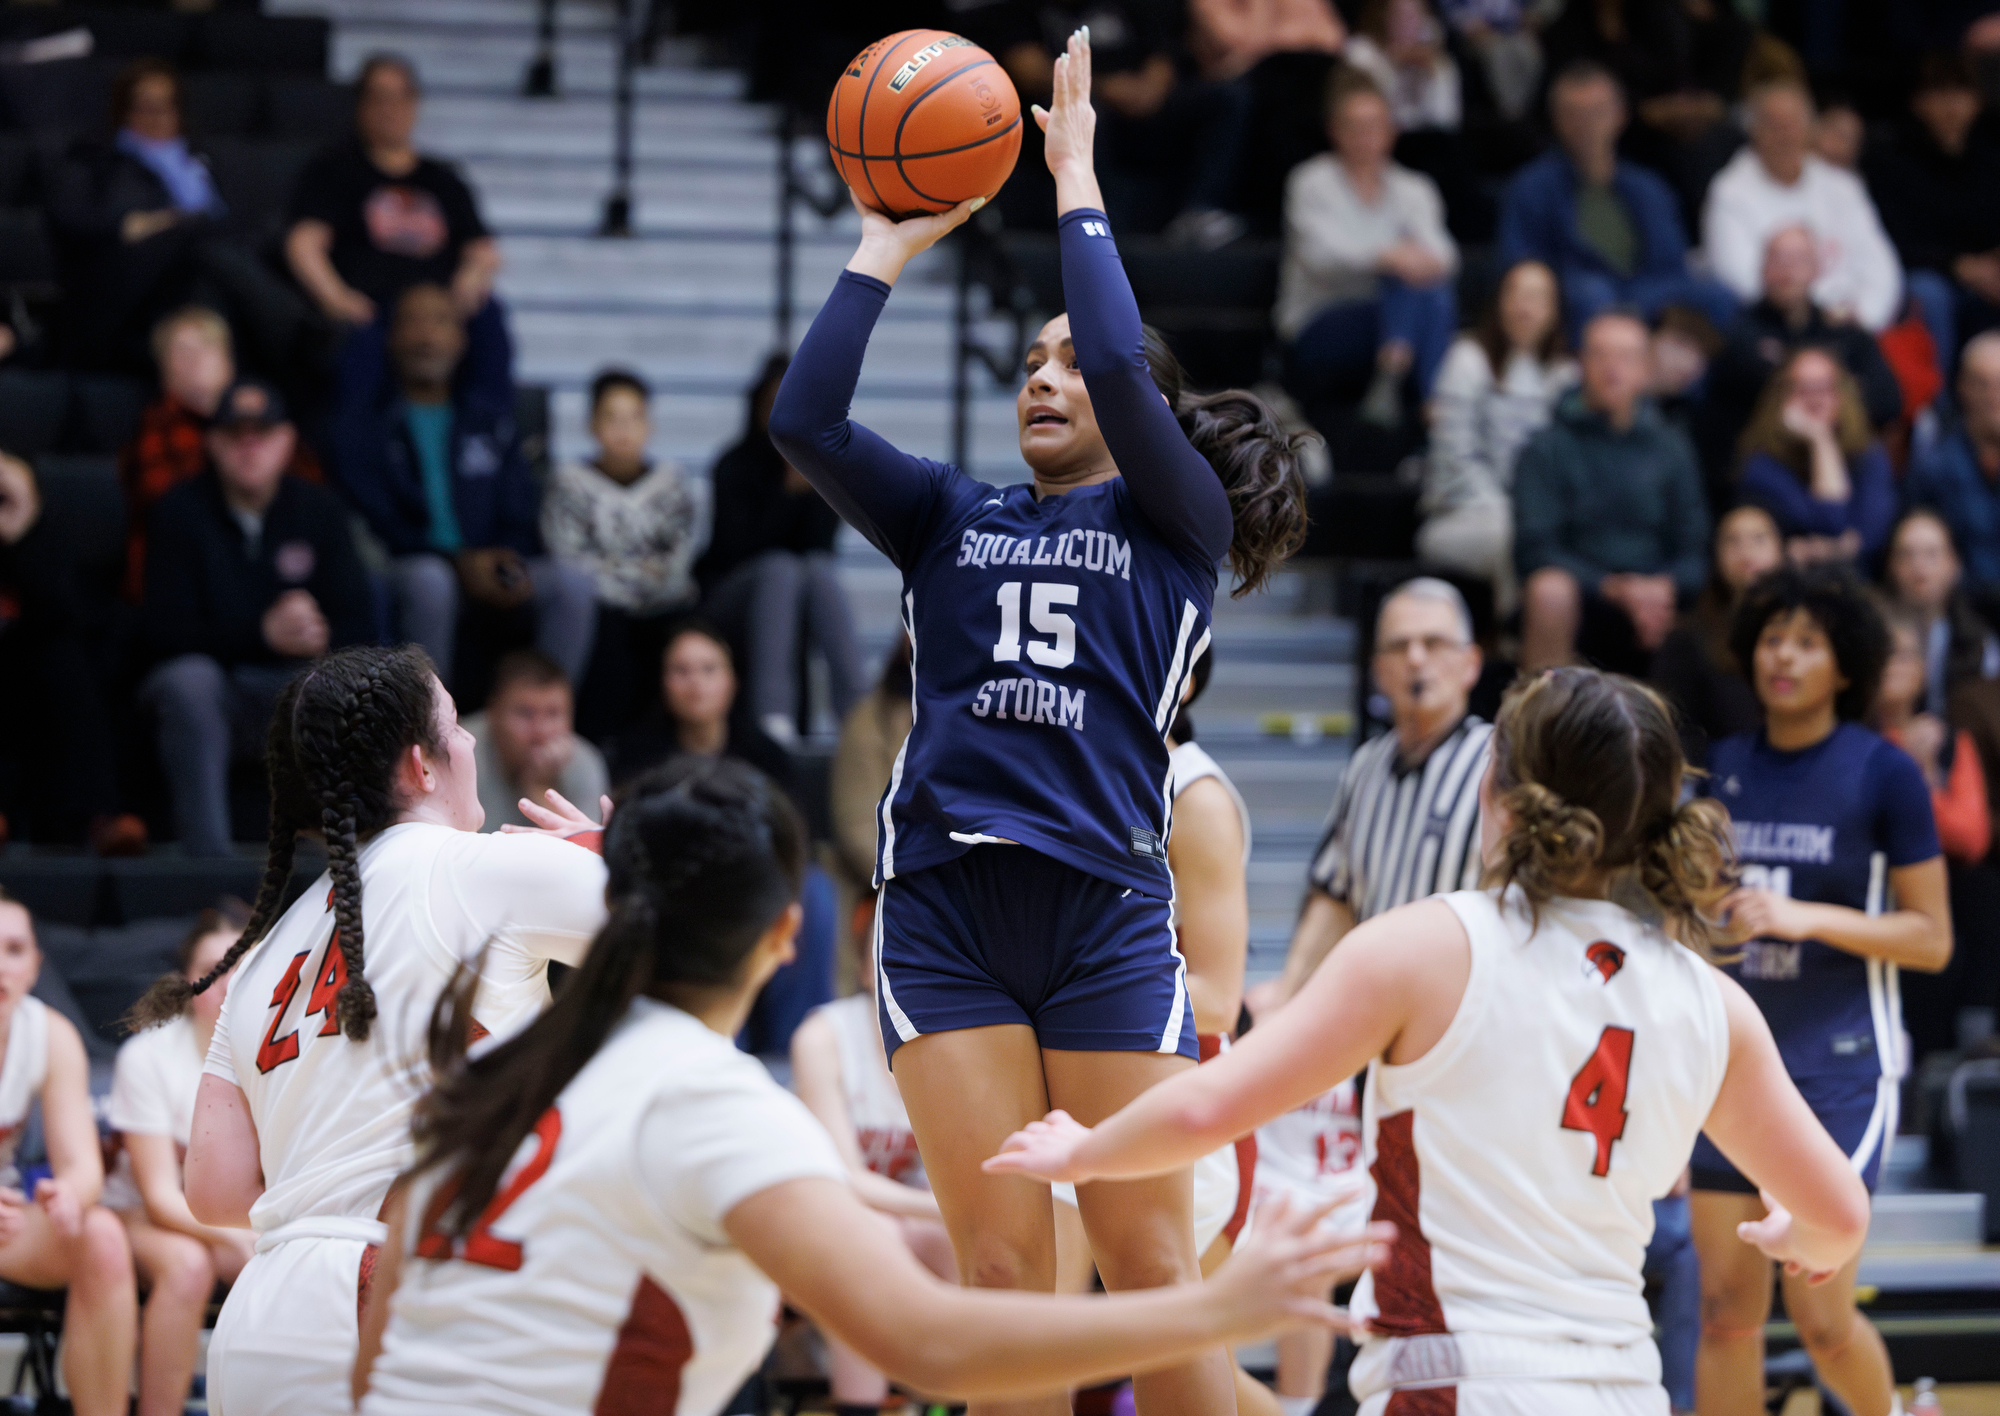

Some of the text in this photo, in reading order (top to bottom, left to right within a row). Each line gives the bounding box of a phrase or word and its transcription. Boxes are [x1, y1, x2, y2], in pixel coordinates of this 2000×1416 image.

[956, 528, 1132, 581] SQUALICUM
[993, 581, 1079, 669] 15
[972, 677, 1086, 731] STORM
[1559, 1023, 1635, 1178] 4
